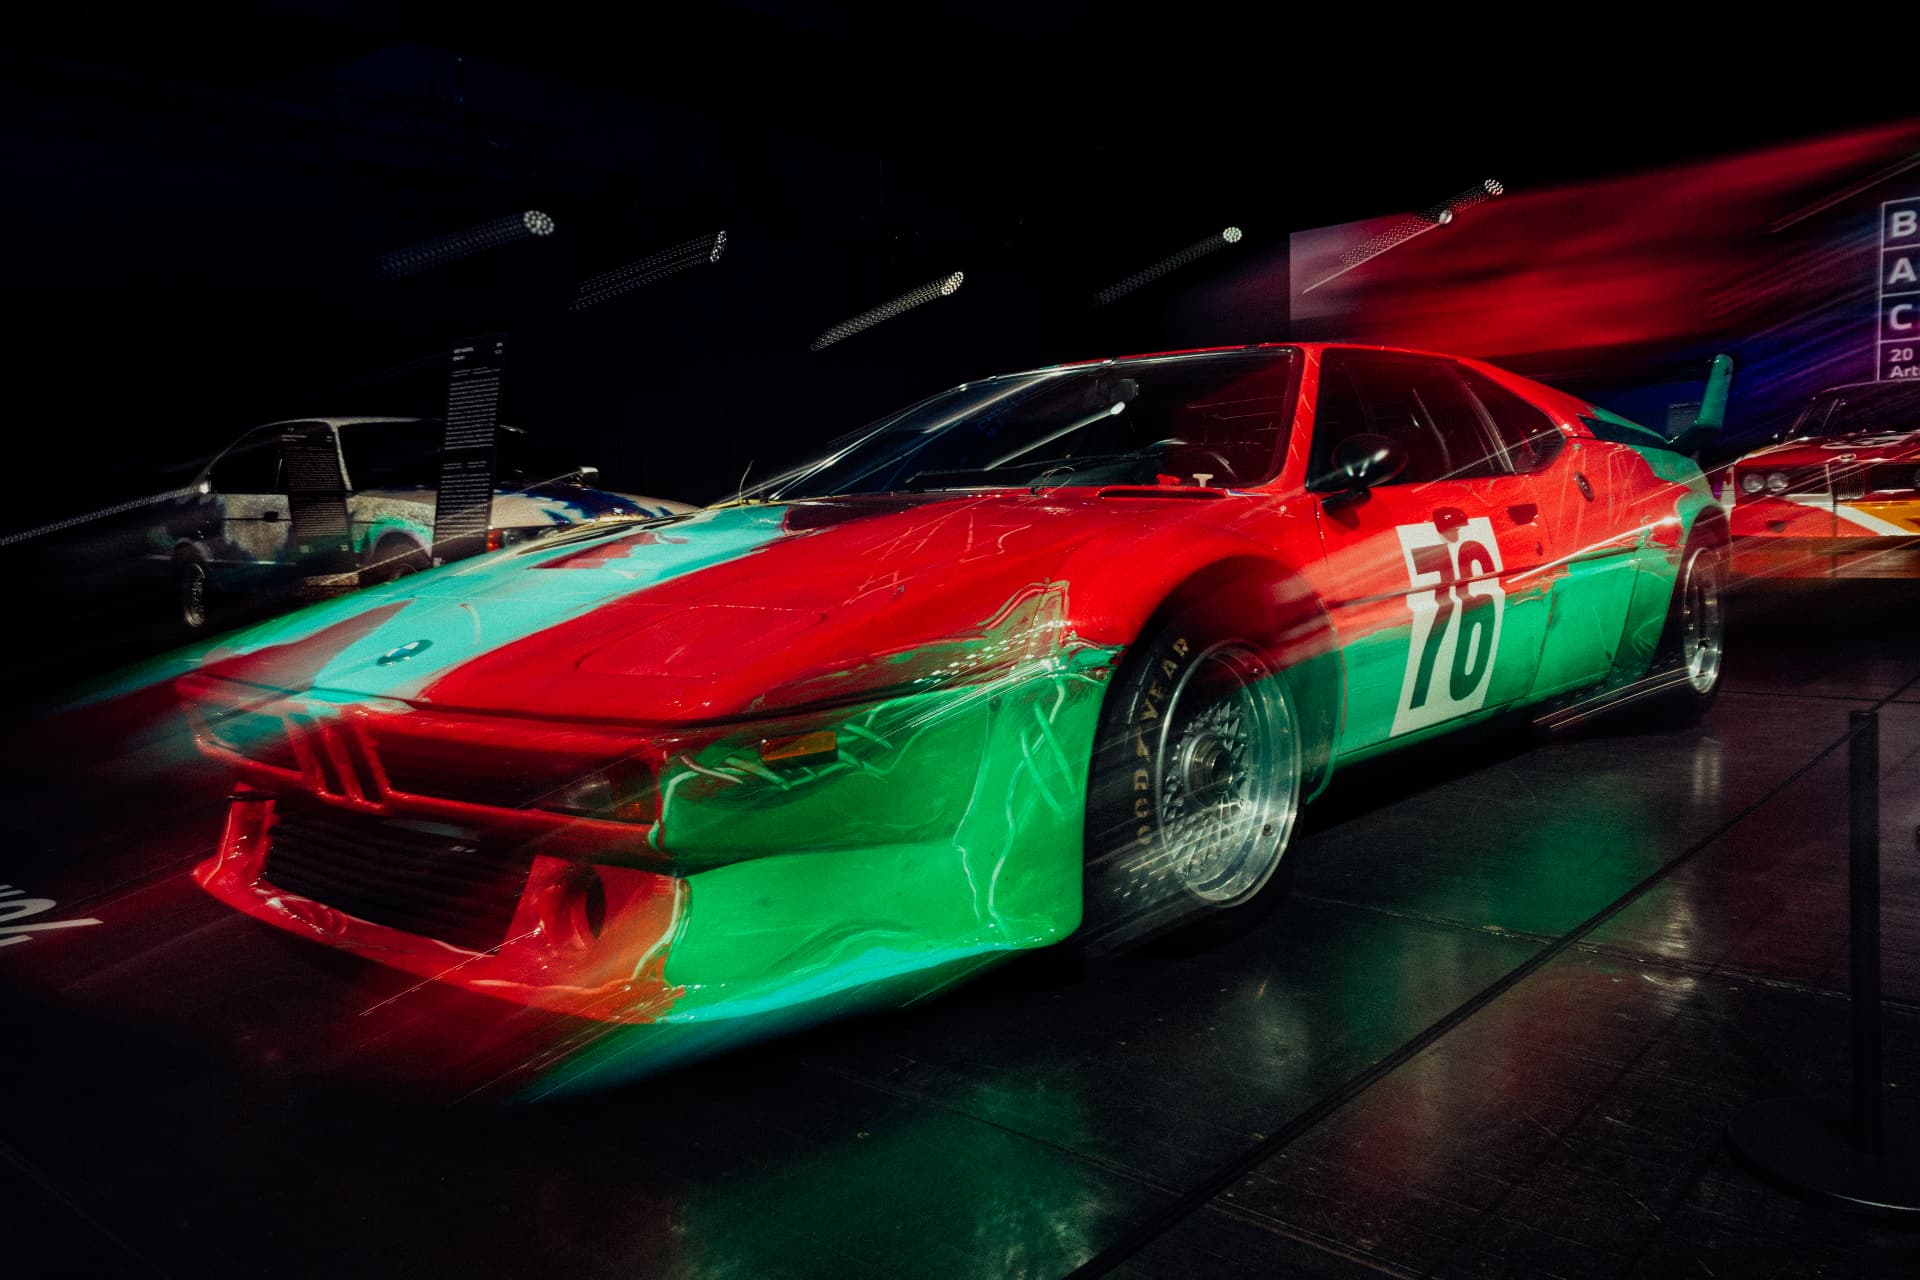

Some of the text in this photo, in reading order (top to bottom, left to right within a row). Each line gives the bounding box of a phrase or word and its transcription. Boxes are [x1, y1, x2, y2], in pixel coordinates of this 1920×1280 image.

[1891, 210, 1918, 238] B
[1888, 256, 1918, 285] A
[1888, 303, 1914, 331] C
[1888, 347, 1914, 363] 20
[1889, 364, 1920, 379] Art
